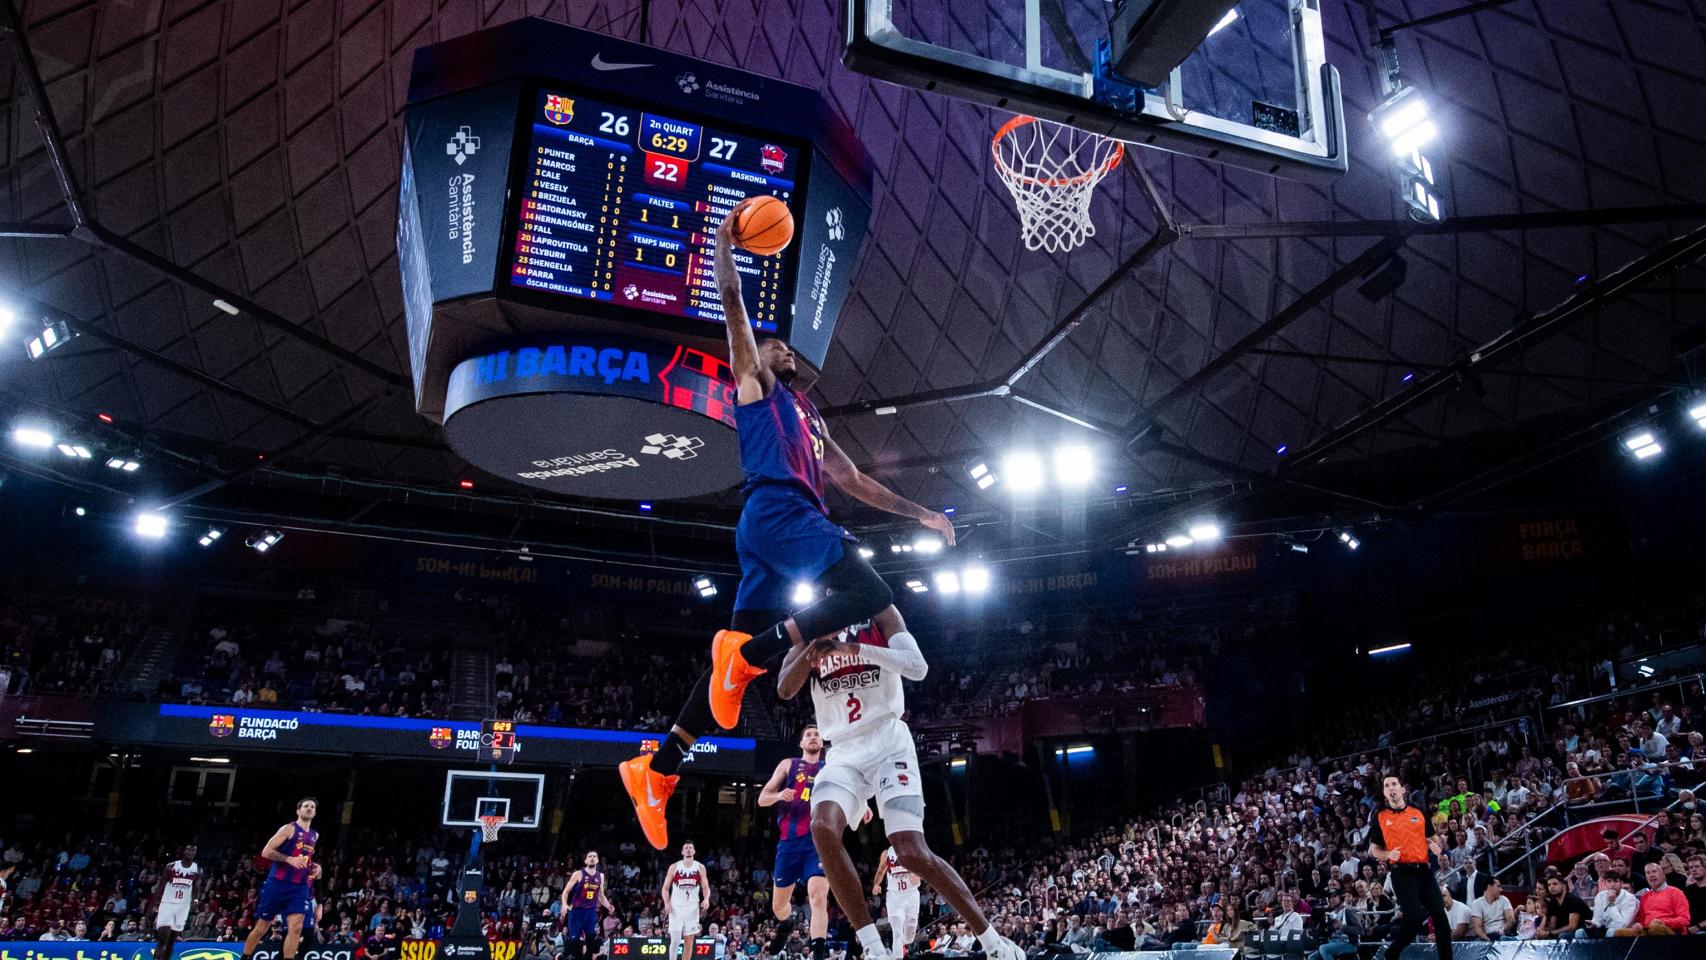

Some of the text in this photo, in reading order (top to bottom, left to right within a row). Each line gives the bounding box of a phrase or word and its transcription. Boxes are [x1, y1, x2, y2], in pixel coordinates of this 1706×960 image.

[600, 112, 629, 136] 26
[650, 120, 694, 136] 2n QUART
[569, 135, 594, 146] BARÇA
[652, 133, 687, 152] 6:29
[544, 148, 575, 161] PUNTER
[709, 137, 737, 160] 27
[543, 159, 576, 172] MARCOS
[653, 161, 678, 182] 22
[541, 170, 560, 180] CALE
[731, 171, 767, 184] BASKONIA
[540, 181, 568, 192] VESELY
[713, 186, 745, 198] HOWARD
[538, 192, 576, 206] BRIZUELA
[649, 198, 674, 209] FALTES
[449, 176, 461, 239] Sanitària
[537, 203, 587, 219] SATORANSKY
[462, 173, 475, 264] Assistència
[535, 215, 594, 232] HERNANGÓMEZ
[641, 209, 679, 228] 1 1
[534, 225, 552, 234] FALL
[532, 236, 588, 252] LAPROVITTOLA
[634, 236, 679, 250] TEMPS MORT
[530, 247, 566, 259] CLYBURN
[635, 248, 676, 267] 1 0
[529, 258, 572, 272] SHENGELIA
[810, 244, 829, 300] Sanitària
[527, 269, 554, 280] PARRA
[526, 278, 548, 288] ÓSCAR
[549, 283, 582, 294] ORELLANA
[812, 249, 836, 330] Assistència
[698, 311, 718, 319] PAOLO
[516, 346, 650, 384] BARÇA
[846, 698, 862, 724] 2
[240, 716, 298, 730] FUNDACIÓ
[238, 728, 277, 740] BARÇA
[614, 945, 629, 954] 26
[641, 945, 667, 954] 6:29
[696, 945, 710, 954] 27
